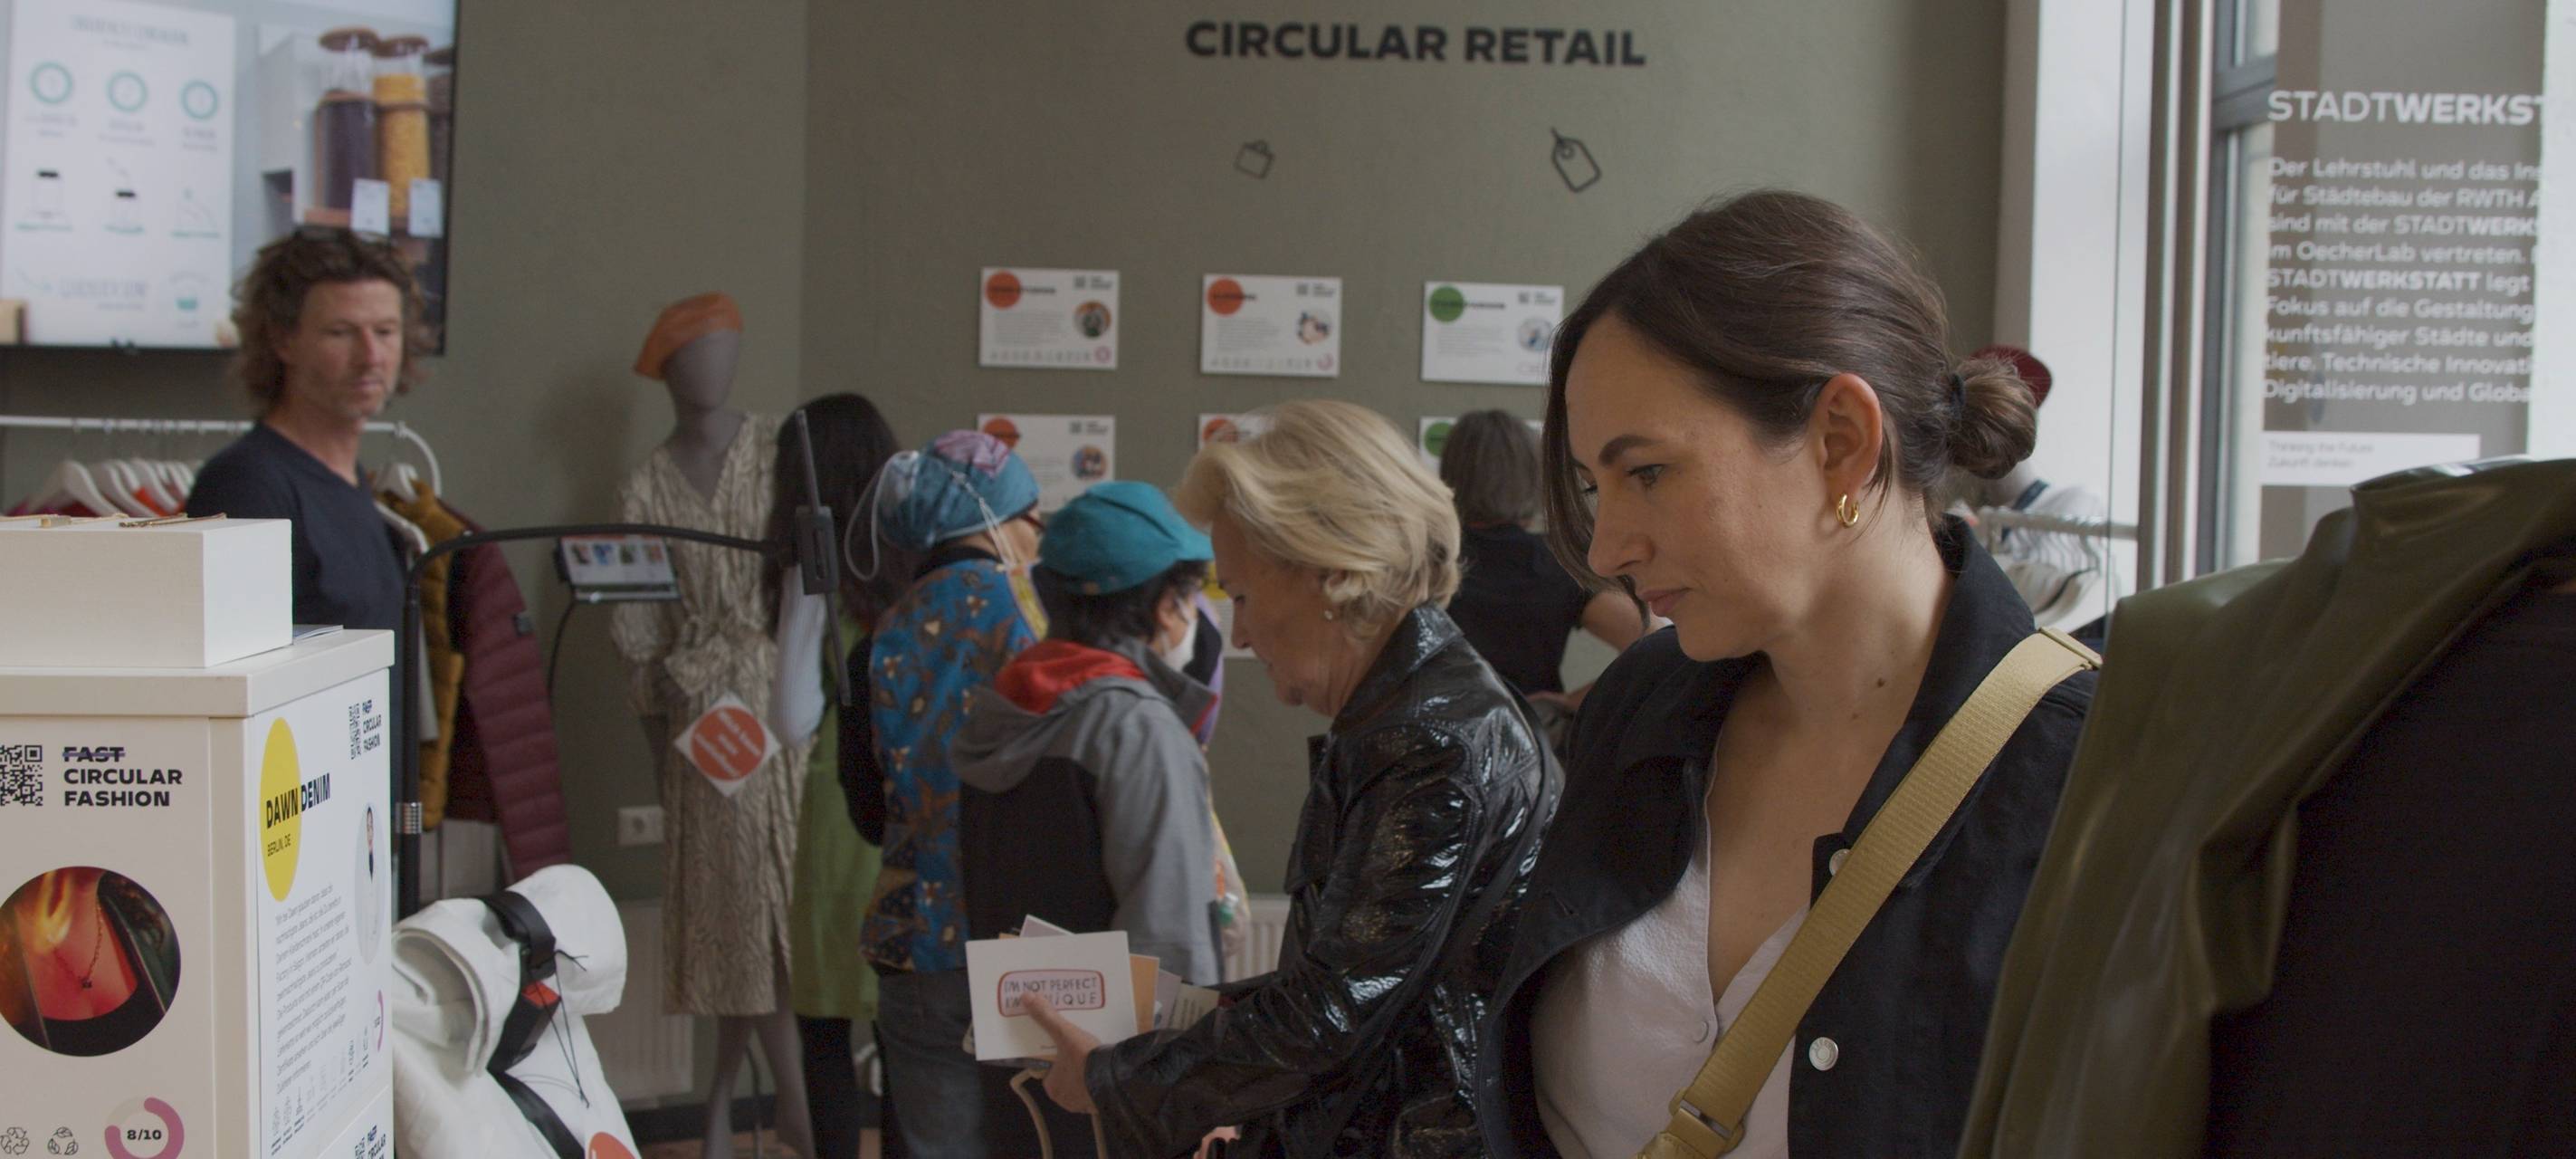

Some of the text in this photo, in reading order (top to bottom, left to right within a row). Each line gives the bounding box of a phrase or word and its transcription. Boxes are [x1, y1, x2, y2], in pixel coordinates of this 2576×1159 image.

[1185, 21, 1646, 65] CIRCULAR RETAIL
[2269, 157, 2307, 177] Der
[2313, 157, 2416, 179] Lehrstuhl
[2421, 160, 2464, 180] und
[2468, 161, 2509, 181] das
[2303, 185, 2413, 206] Städtebau
[2418, 187, 2453, 206] der
[2457, 188, 2524, 208] RWTH
[2315, 213, 2349, 233] mit
[2354, 214, 2390, 234] der
[2394, 216, 2537, 235] STADTWERK
[2296, 241, 2415, 262] OecherLab
[2420, 244, 2525, 263] vertreten.
[2267, 268, 2530, 297] STADTWERKSTATT legt
[2266, 294, 2534, 324] Fokus auf die Gestaltung
[2413, 326, 2487, 348] Städte
[2322, 351, 2440, 373] Technische
[2263, 378, 2418, 406] Digitalisierung
[2421, 381, 2465, 401] und
[62, 746, 125, 762] FAST
[63, 769, 183, 784] CIRCULAR
[64, 790, 170, 807] FASHION
[266, 772, 330, 829] DAWN DENIM
[1050, 977, 1097, 991] PERFECT
[127, 1129, 162, 1141] 8/10
